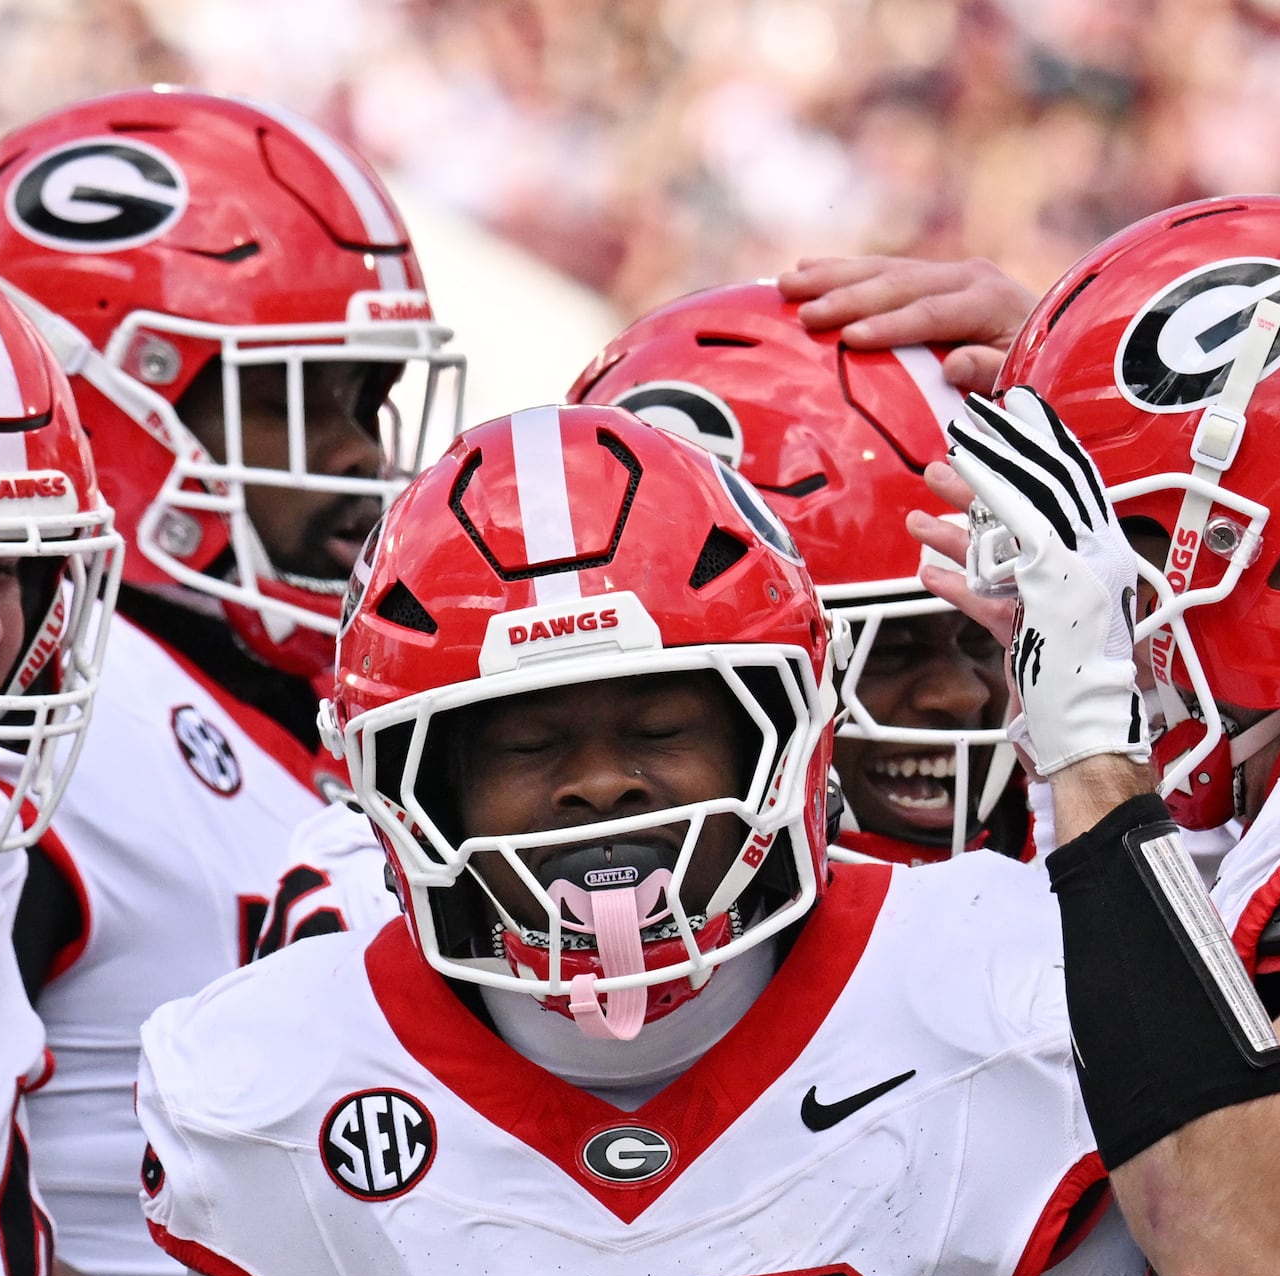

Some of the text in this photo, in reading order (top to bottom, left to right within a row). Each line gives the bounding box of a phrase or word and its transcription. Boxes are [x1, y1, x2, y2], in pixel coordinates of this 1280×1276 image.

[9, 140, 184, 248] G
[508, 608, 619, 646] DAWGS
[589, 869, 635, 884] BATTLE
[327, 1093, 430, 1194] SEC
[582, 1126, 672, 1182] G
